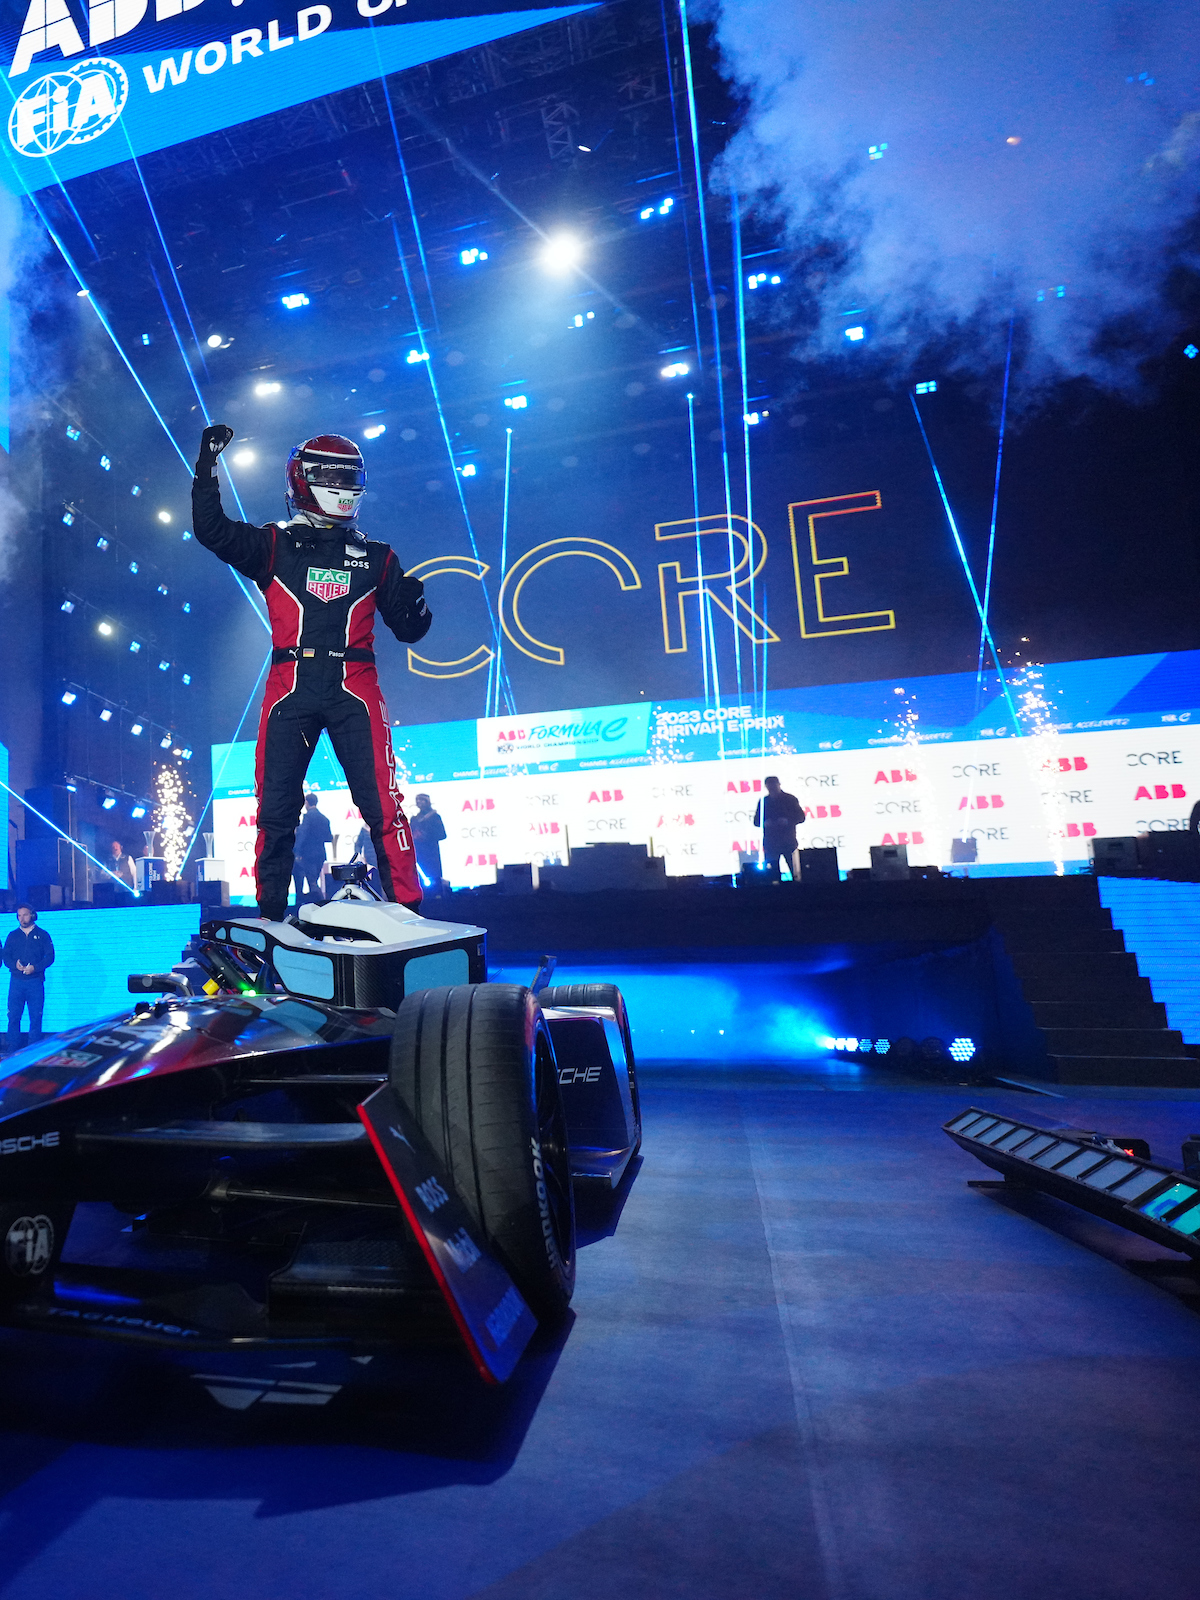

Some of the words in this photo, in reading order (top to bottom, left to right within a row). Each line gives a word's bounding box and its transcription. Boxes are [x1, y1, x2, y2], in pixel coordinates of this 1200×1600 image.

[142, 4, 333, 94] WORLD
[344, 560, 370, 569] BOSS
[311, 570, 347, 583] TAG
[309, 582, 347, 599] HEUER
[656, 710, 701, 726] 2023
[702, 705, 752, 722] CORE
[496, 730, 526, 742] ABB
[528, 720, 600, 741] FORMULA
[656, 721, 724, 738] DIRIYAH
[727, 715, 785, 733] E-PRIX
[588, 789, 624, 803] ABB
[874, 769, 918, 784] ABB
[952, 763, 1001, 778] CORE
[1126, 750, 1183, 767] CORE
[588, 817, 627, 831] CORE
[875, 800, 922, 815] CORE
[958, 794, 1005, 811] ABB
[1134, 783, 1187, 801] ABB
[881, 831, 924, 846] ABB
